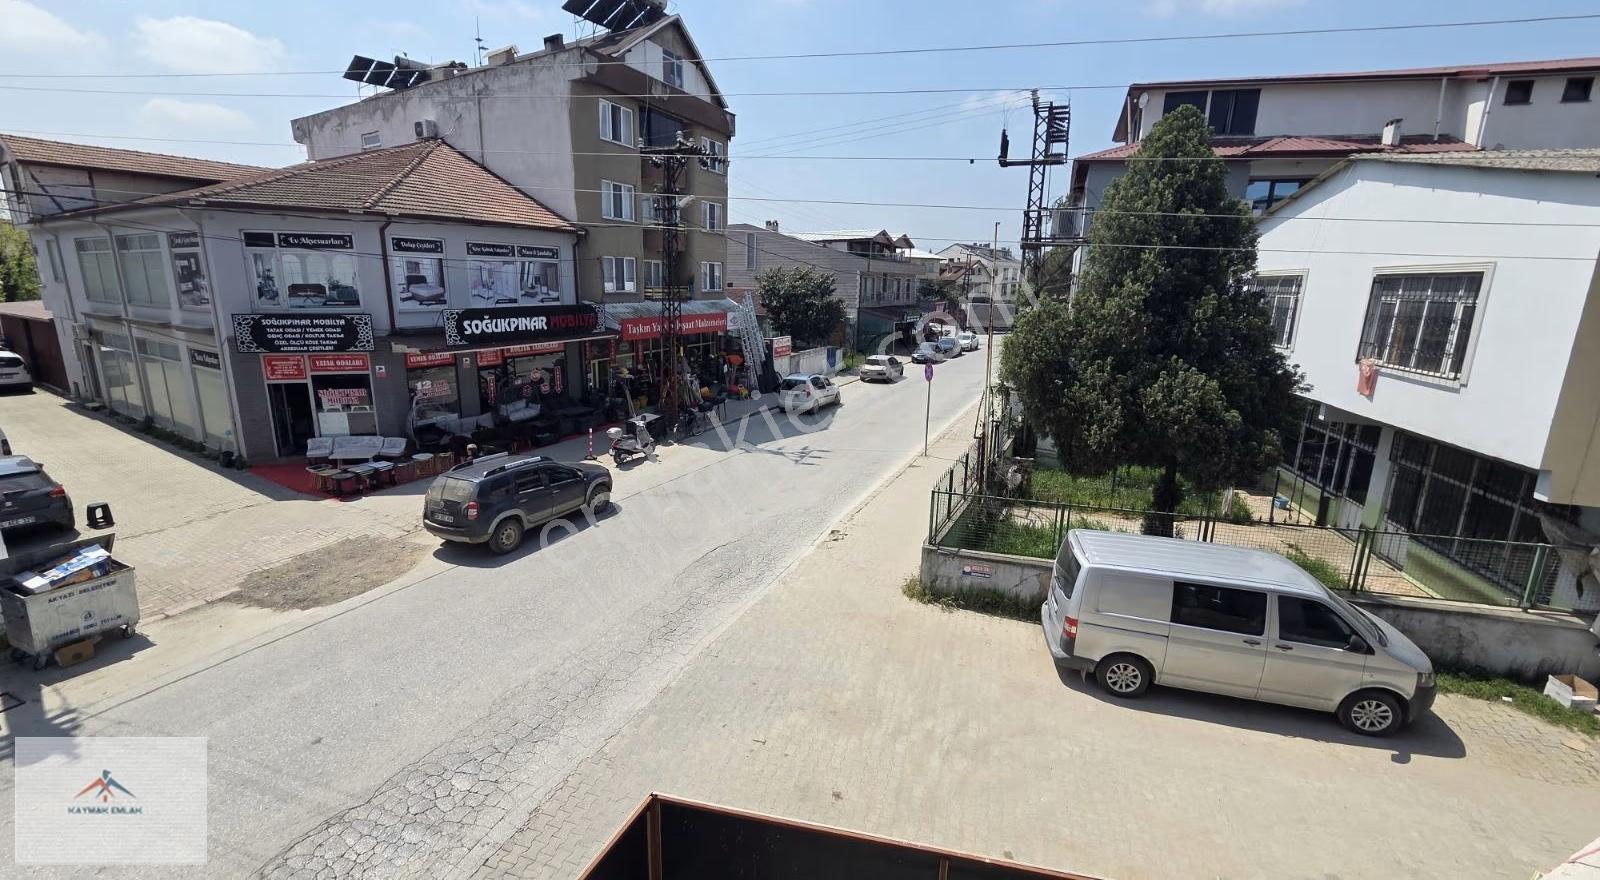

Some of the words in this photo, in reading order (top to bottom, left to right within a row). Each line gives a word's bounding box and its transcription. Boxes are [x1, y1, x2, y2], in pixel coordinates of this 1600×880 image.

[261, 317, 312, 326] SOĞUKPINAR
[313, 317, 346, 326] MOBİLYA
[463, 315, 548, 335] SOĞUKPINAR
[627, 322, 652, 335] Taşkın
[415, 380, 432, 390] 12
